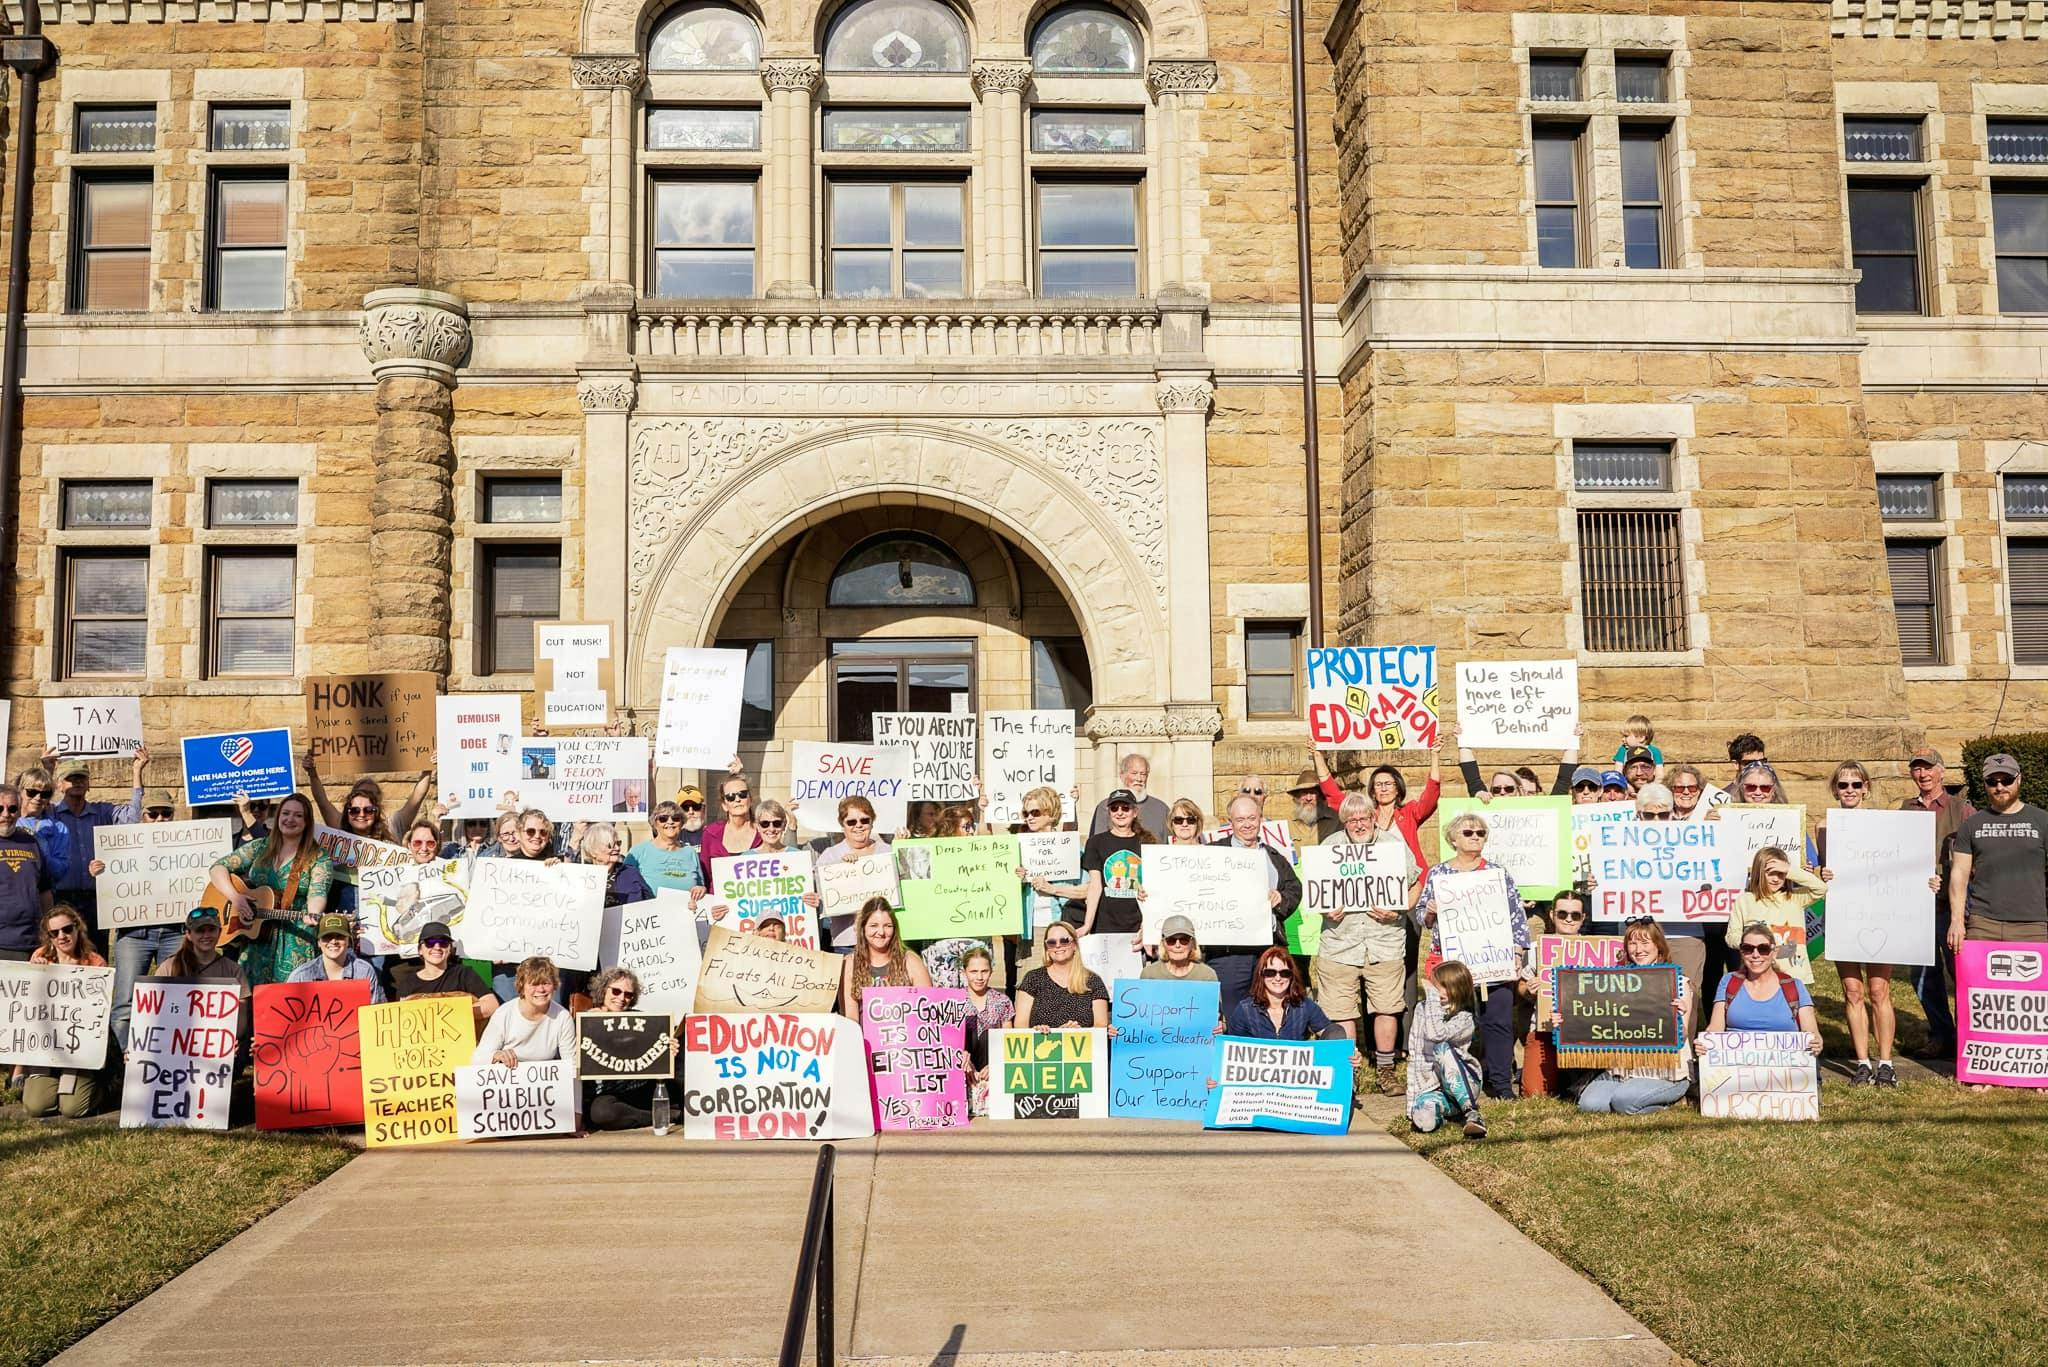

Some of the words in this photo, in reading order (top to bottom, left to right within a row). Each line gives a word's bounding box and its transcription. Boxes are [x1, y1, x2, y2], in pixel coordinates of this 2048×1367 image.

[671, 385, 806, 405] RANDOLPH
[822, 385, 928, 405] COUNTY
[940, 384, 1021, 404] COURT
[1036, 384, 1120, 405] HOUSE.
[1107, 443, 1144, 464] 1902
[545, 638, 565, 647] CUT
[572, 638, 602, 647] MUSK!
[566, 671, 585, 680] NOT
[1307, 645, 1436, 690] PROTECT
[1465, 668, 1498, 683] We
[1510, 666, 1563, 682] should
[313, 681, 384, 711] HONK
[390, 688, 401, 702] if
[403, 692, 422, 706] you
[1465, 688, 1502, 705] have
[1510, 685, 1545, 700] left
[73, 706, 118, 725] TAX
[457, 713, 500, 724] DEMOLISH
[547, 704, 605, 713] EDUCATION!
[1309, 686, 1438, 749] EDUCATION
[1466, 703, 1506, 715] some
[1513, 700, 1534, 713] of
[1537, 706, 1571, 719] you
[315, 716, 340, 729] have
[394, 712, 409, 724] of
[877, 716, 893, 735] IF
[897, 716, 924, 736] YOU
[990, 716, 1024, 735] The
[1029, 715, 1073, 735] future
[1491, 717, 1548, 735] Behind
[311, 733, 389, 757] EMPATHY
[396, 729, 416, 744] left
[460, 738, 488, 750] DOGE
[557, 741, 580, 751] YOU
[585, 741, 622, 751] CAN'T
[566, 754, 603, 764] SPELL
[992, 741, 1010, 759] of
[1026, 744, 1056, 759] the
[191, 774, 211, 783] HATE
[242, 768, 265, 777] HOME
[266, 766, 288, 775] HERE.
[471, 762, 489, 772] NOT
[564, 767, 606, 777] FELON
[818, 754, 874, 775] SAVE
[913, 761, 972, 782] PAYING
[1003, 764, 1056, 783] world
[468, 788, 494, 799] DOE
[549, 780, 610, 791] WITHOUT
[796, 779, 902, 800] DEMOCRACY
[100, 832, 145, 848] PUBLIC
[152, 826, 224, 844] EDUCATION
[1060, 837, 1071, 845] UP
[1601, 825, 1716, 848] ENOUGH
[1974, 829, 2039, 839] SCIENTISTS
[1038, 848, 1054, 856] FOR
[1331, 844, 1377, 864] SAVE
[1652, 847, 1675, 861] IS
[110, 859, 140, 875] OUR
[148, 851, 218, 872] SCHOOLS
[733, 859, 781, 880] FREE
[823, 865, 857, 881] Save
[862, 859, 892, 876] Our
[1339, 863, 1366, 877] OUR
[1604, 858, 1723, 882] ENOUGH!
[116, 880, 152, 899] OUR
[168, 877, 205, 894] KIDS
[361, 866, 405, 891] STOP
[723, 875, 807, 899] SOCIETIES
[490, 887, 577, 912] Deserve
[935, 883, 968, 898] Country
[1307, 875, 1408, 909] DEMOCRACY
[737, 896, 807, 918] SUPPORT
[1169, 900, 1239, 913] STRONG
[1602, 890, 1665, 915] FIRE
[112, 904, 149, 923] OUR
[480, 905, 580, 943] Community
[623, 914, 661, 934] SAVE
[1441, 903, 1505, 934] Public
[622, 936, 667, 954] PUBLIC
[722, 935, 817, 969] Education
[621, 952, 676, 969] SCHOOLS
[661, 977, 688, 991] CUTS
[704, 958, 761, 983] Floats
[765, 972, 786, 987] All
[792, 974, 838, 991] Boats
[1578, 973, 1643, 995] FUND
[47, 978, 87, 999] OUR
[8, 1001, 82, 1024] PUBLIC
[135, 988, 165, 1015] WV
[170, 1002, 180, 1014] is
[187, 989, 241, 1020] RED
[1116, 987, 1200, 1026] Support
[1572, 1000, 1630, 1017] Public
[1971, 993, 2016, 1012] SAVE
[375, 1002, 462, 1048] HONK
[603, 1017, 647, 1033] TAX
[685, 1013, 836, 1057] EDUCATION
[880, 1026, 908, 1045] IS
[917, 1025, 941, 1046] ON
[1591, 1019, 1664, 1040] Schools!
[131, 1026, 165, 1054] WE
[171, 1028, 236, 1059] NEED
[1114, 1026, 1158, 1045] Public
[1161, 1026, 1215, 1047] Education
[1703, 1032, 1752, 1051] STOP
[394, 1044, 447, 1070] FOR:
[579, 1032, 671, 1073] BILLIONAIRES
[1006, 1037, 1029, 1059] W
[1070, 1036, 1087, 1058] V
[1227, 1045, 1289, 1066] INVEST
[1292, 1049, 1311, 1067] IN
[1708, 1049, 1810, 1066] BILLIONAIRES
[1965, 1043, 2002, 1058] STOP
[2005, 1047, 2043, 1060] CUTS
[714, 1056, 747, 1079] IS
[757, 1046, 801, 1075] NOT
[802, 1058, 821, 1083] A
[871, 1047, 963, 1073] EPSTEIN'S
[137, 1060, 200, 1093] Dept
[205, 1064, 231, 1089] of
[476, 1067, 520, 1087] SAVE
[527, 1065, 560, 1083] OUR
[1126, 1056, 1200, 1087] Support
[1225, 1065, 1328, 1086] EDUCATION.
[1737, 1067, 1809, 1093] FUND
[902, 1073, 947, 1093] LIST
[369, 1093, 457, 1117] TEACHER
[482, 1085, 557, 1111] PUBLIC
[684, 1081, 832, 1117] CORPORATION
[1045, 1093, 1080, 1116] Count
[1115, 1088, 1145, 1108] Our
[1266, 1099, 1303, 1110] Institutes
[1314, 1105, 1340, 1113] Health
[1275, 1092, 1314, 1101] Education
[1701, 1092, 1745, 1118] OUR
[1746, 1093, 1819, 1120] SCHOOLS
[473, 1108, 557, 1134] SCHOOLS
[714, 1110, 827, 1141] ELON!
[1264, 1108, 1293, 1117] Science
[1294, 1113, 1337, 1123] Foundation
